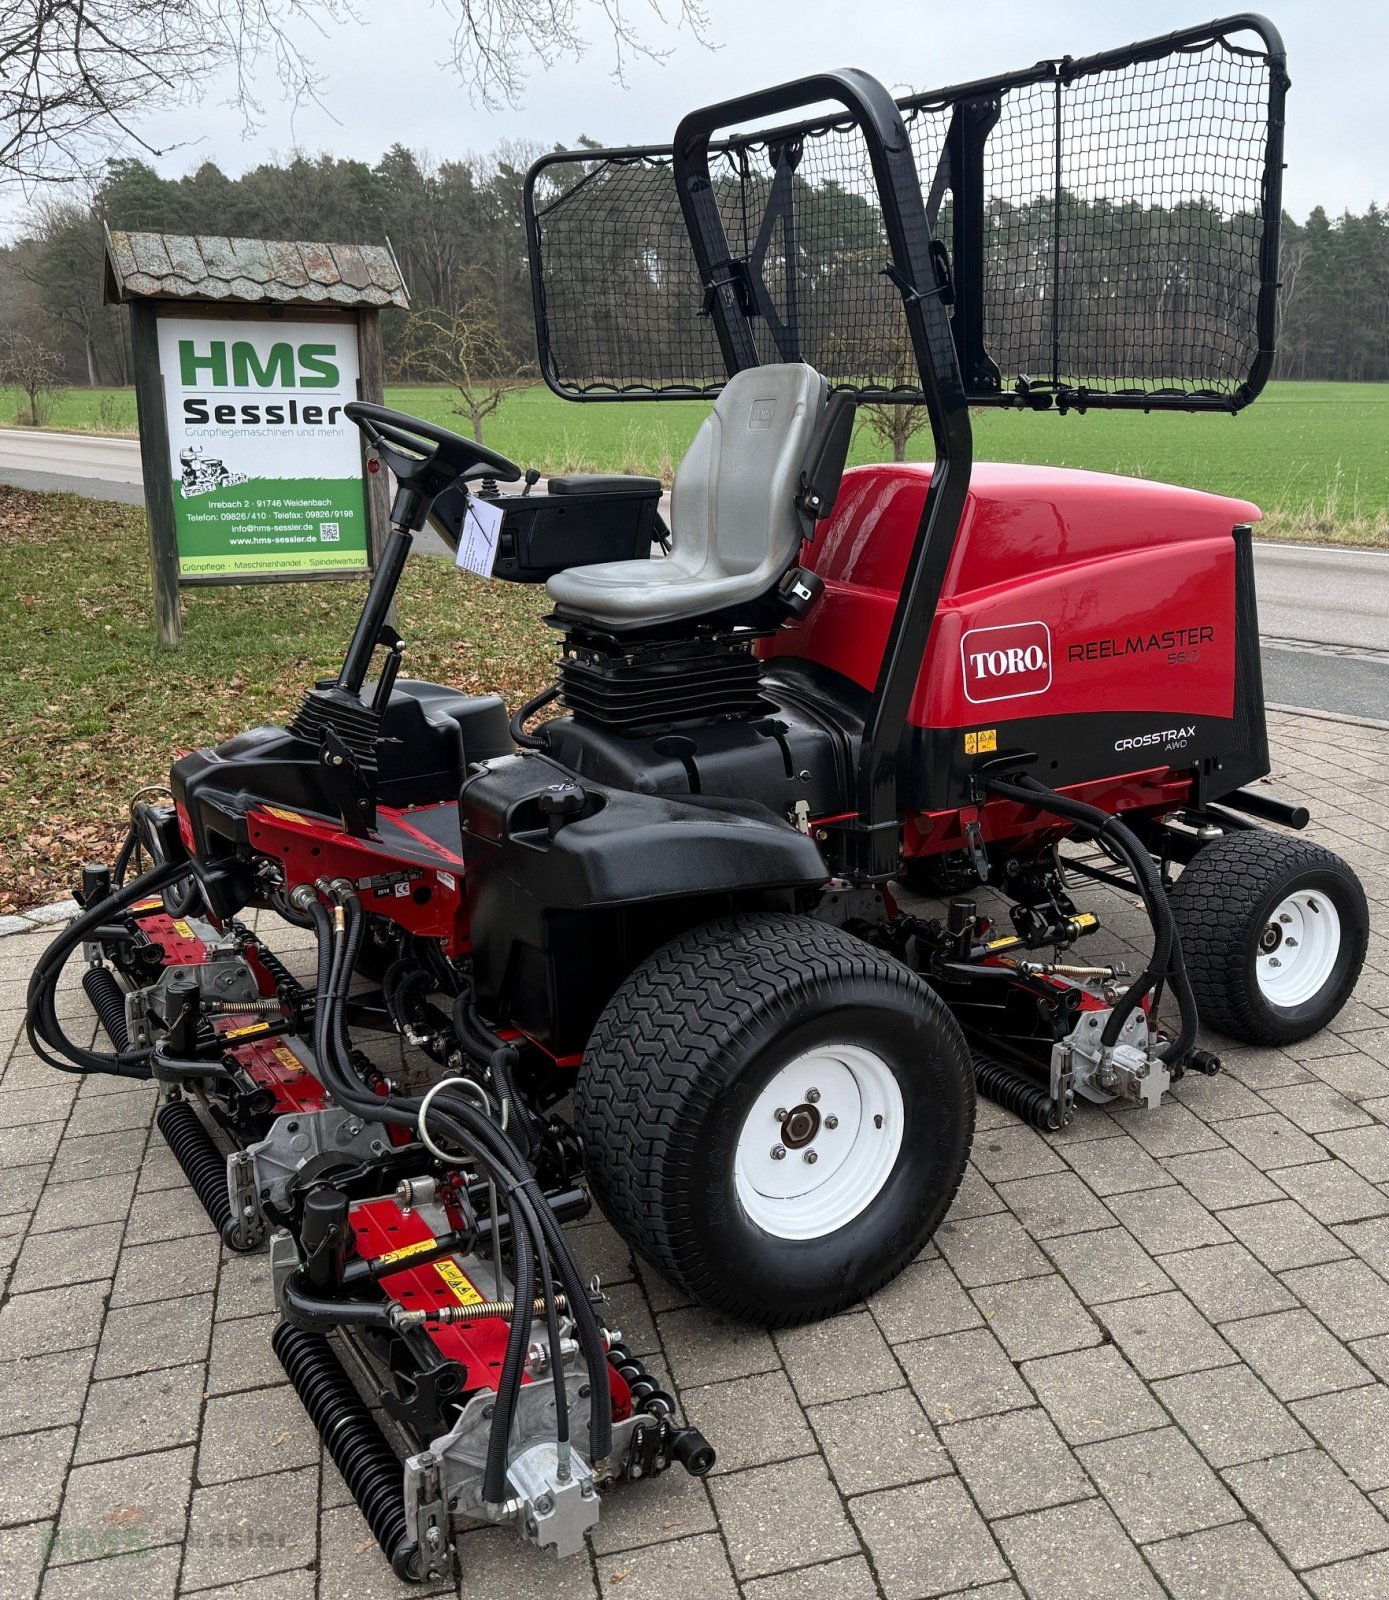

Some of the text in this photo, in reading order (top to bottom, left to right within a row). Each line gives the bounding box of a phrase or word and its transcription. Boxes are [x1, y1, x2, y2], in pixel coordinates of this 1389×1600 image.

[178, 340, 340, 388] HMS
[183, 398, 342, 425] Sessler
[185, 427, 294, 439] Grünpflegemaschinen
[296, 427, 315, 437] und
[208, 500, 243, 509] Irrebach
[256, 500, 282, 508] 91746
[283, 498, 332, 507] Weidenbach
[187, 513, 219, 522] Telefon:
[273, 511, 304, 520] Telefax:
[231, 523, 313, 533] info@hms-sessler.de
[229, 535, 317, 546] www.hms-sessler.de
[182, 557, 365, 573] Grünpflege Maschinenhandel Spindelwartung
[1068, 625, 1214, 663] REELMASTER
[1167, 650, 1200, 665] 5610
[1114, 725, 1196, 752] CROSSTRAX
[1165, 739, 1187, 751] AWD
